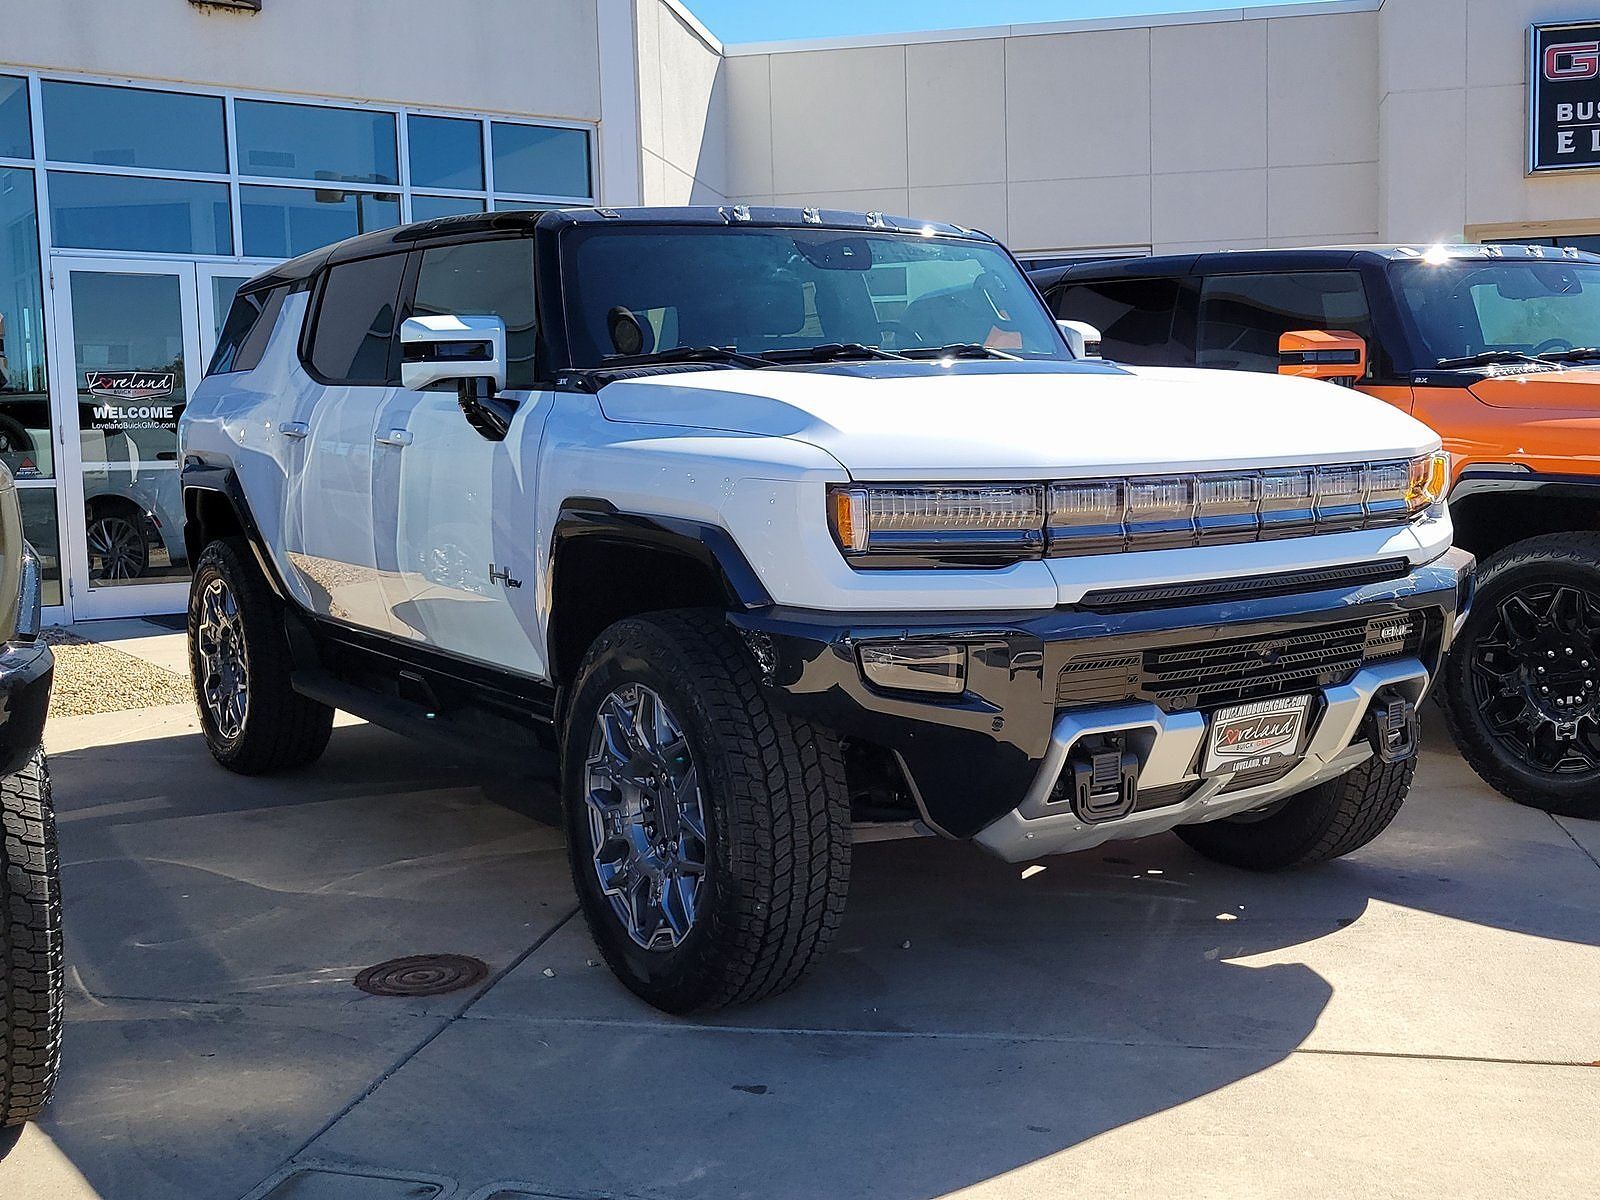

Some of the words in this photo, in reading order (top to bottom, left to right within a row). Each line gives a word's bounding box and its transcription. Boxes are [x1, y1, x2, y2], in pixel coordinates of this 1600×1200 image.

[1557, 101, 1600, 122] BU
[87, 372, 171, 389] Loveland
[93, 406, 174, 419] WELCOME
[91, 421, 176, 430] LovelandBuickGMC.com
[1381, 622, 1414, 639] GMC
[1216, 694, 1310, 721] LOVELANDBUICKGMC.COM
[1215, 715, 1294, 744] Loveland
[1236, 742, 1254, 751] BUICK
[1256, 739, 1273, 747] GMC
[1262, 756, 1271, 766] CO
